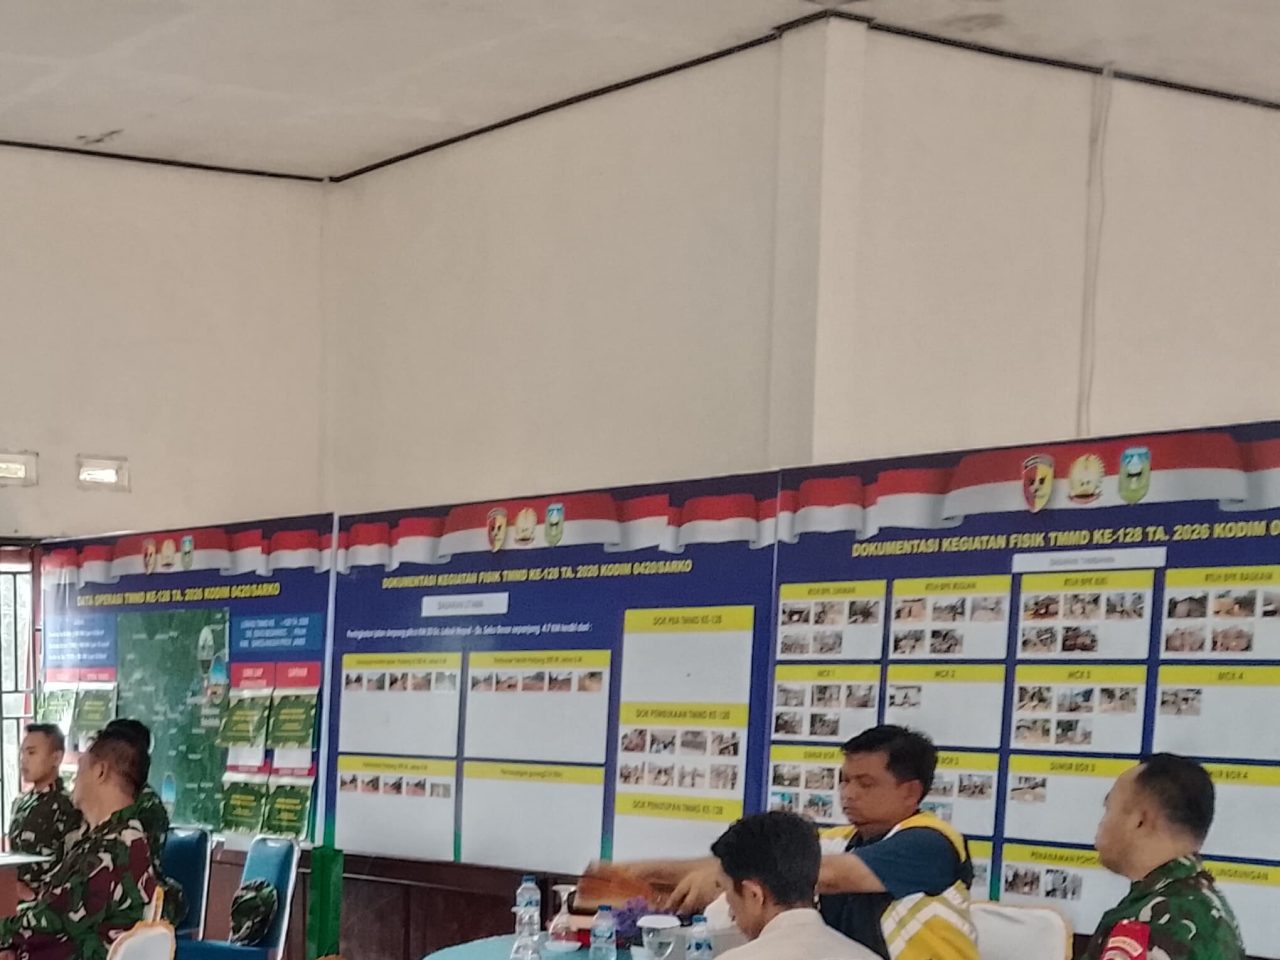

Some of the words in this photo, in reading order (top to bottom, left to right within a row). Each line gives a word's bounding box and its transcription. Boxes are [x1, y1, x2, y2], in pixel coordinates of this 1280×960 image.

[851, 537, 939, 558] DOKUMENTASI
[941, 534, 1006, 553] KEGIATAN
[1009, 531, 1045, 549] FISIK
[1048, 529, 1091, 547] TMMD
[1145, 525, 1170, 541] TA.
[1172, 524, 1210, 541] 2026
[1213, 520, 1267, 538] KODIM
